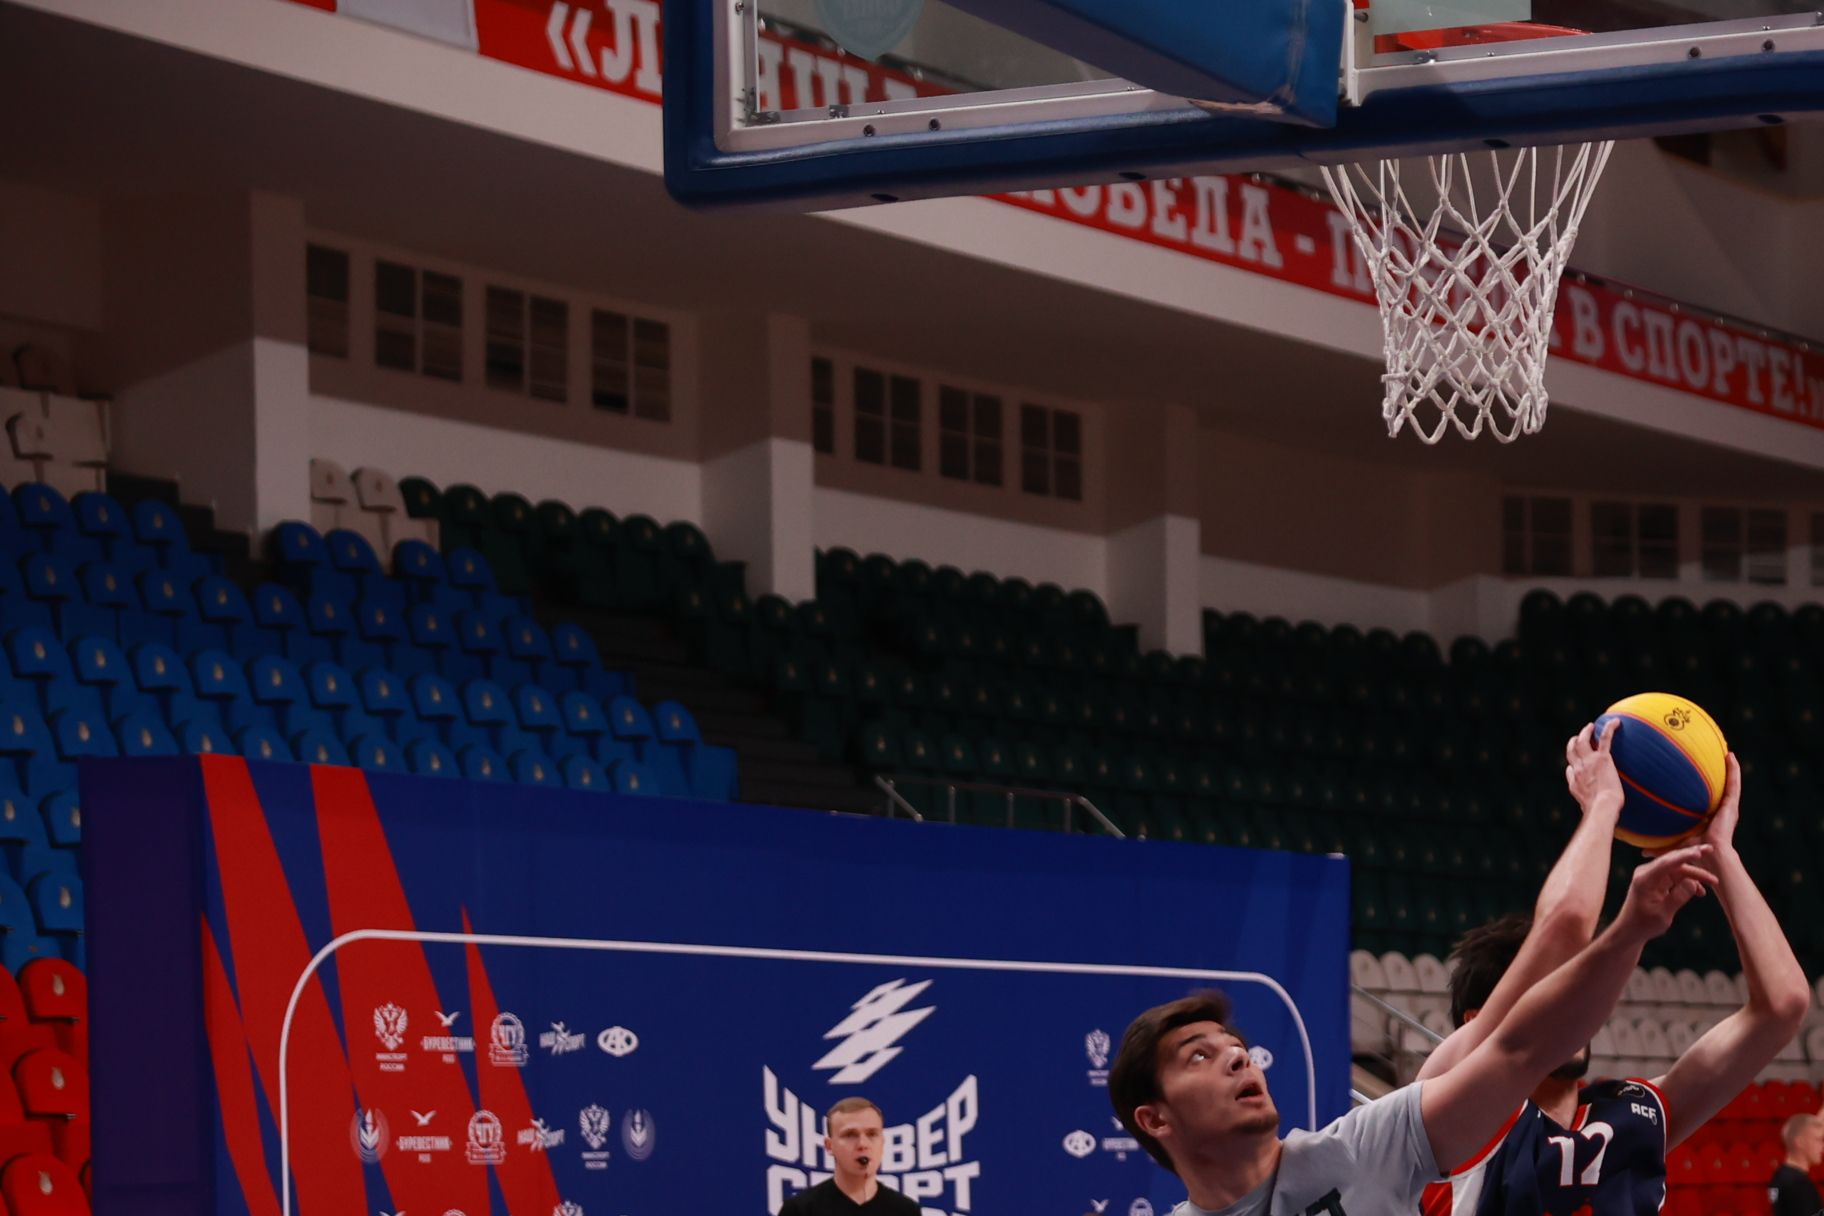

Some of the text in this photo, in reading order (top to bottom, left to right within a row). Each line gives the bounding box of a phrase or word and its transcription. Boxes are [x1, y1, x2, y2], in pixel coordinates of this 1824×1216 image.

[1569, 285, 1604, 360] В
[763, 1064, 979, 1172] УНВЕР
[1547, 1120, 1614, 1187] 12
